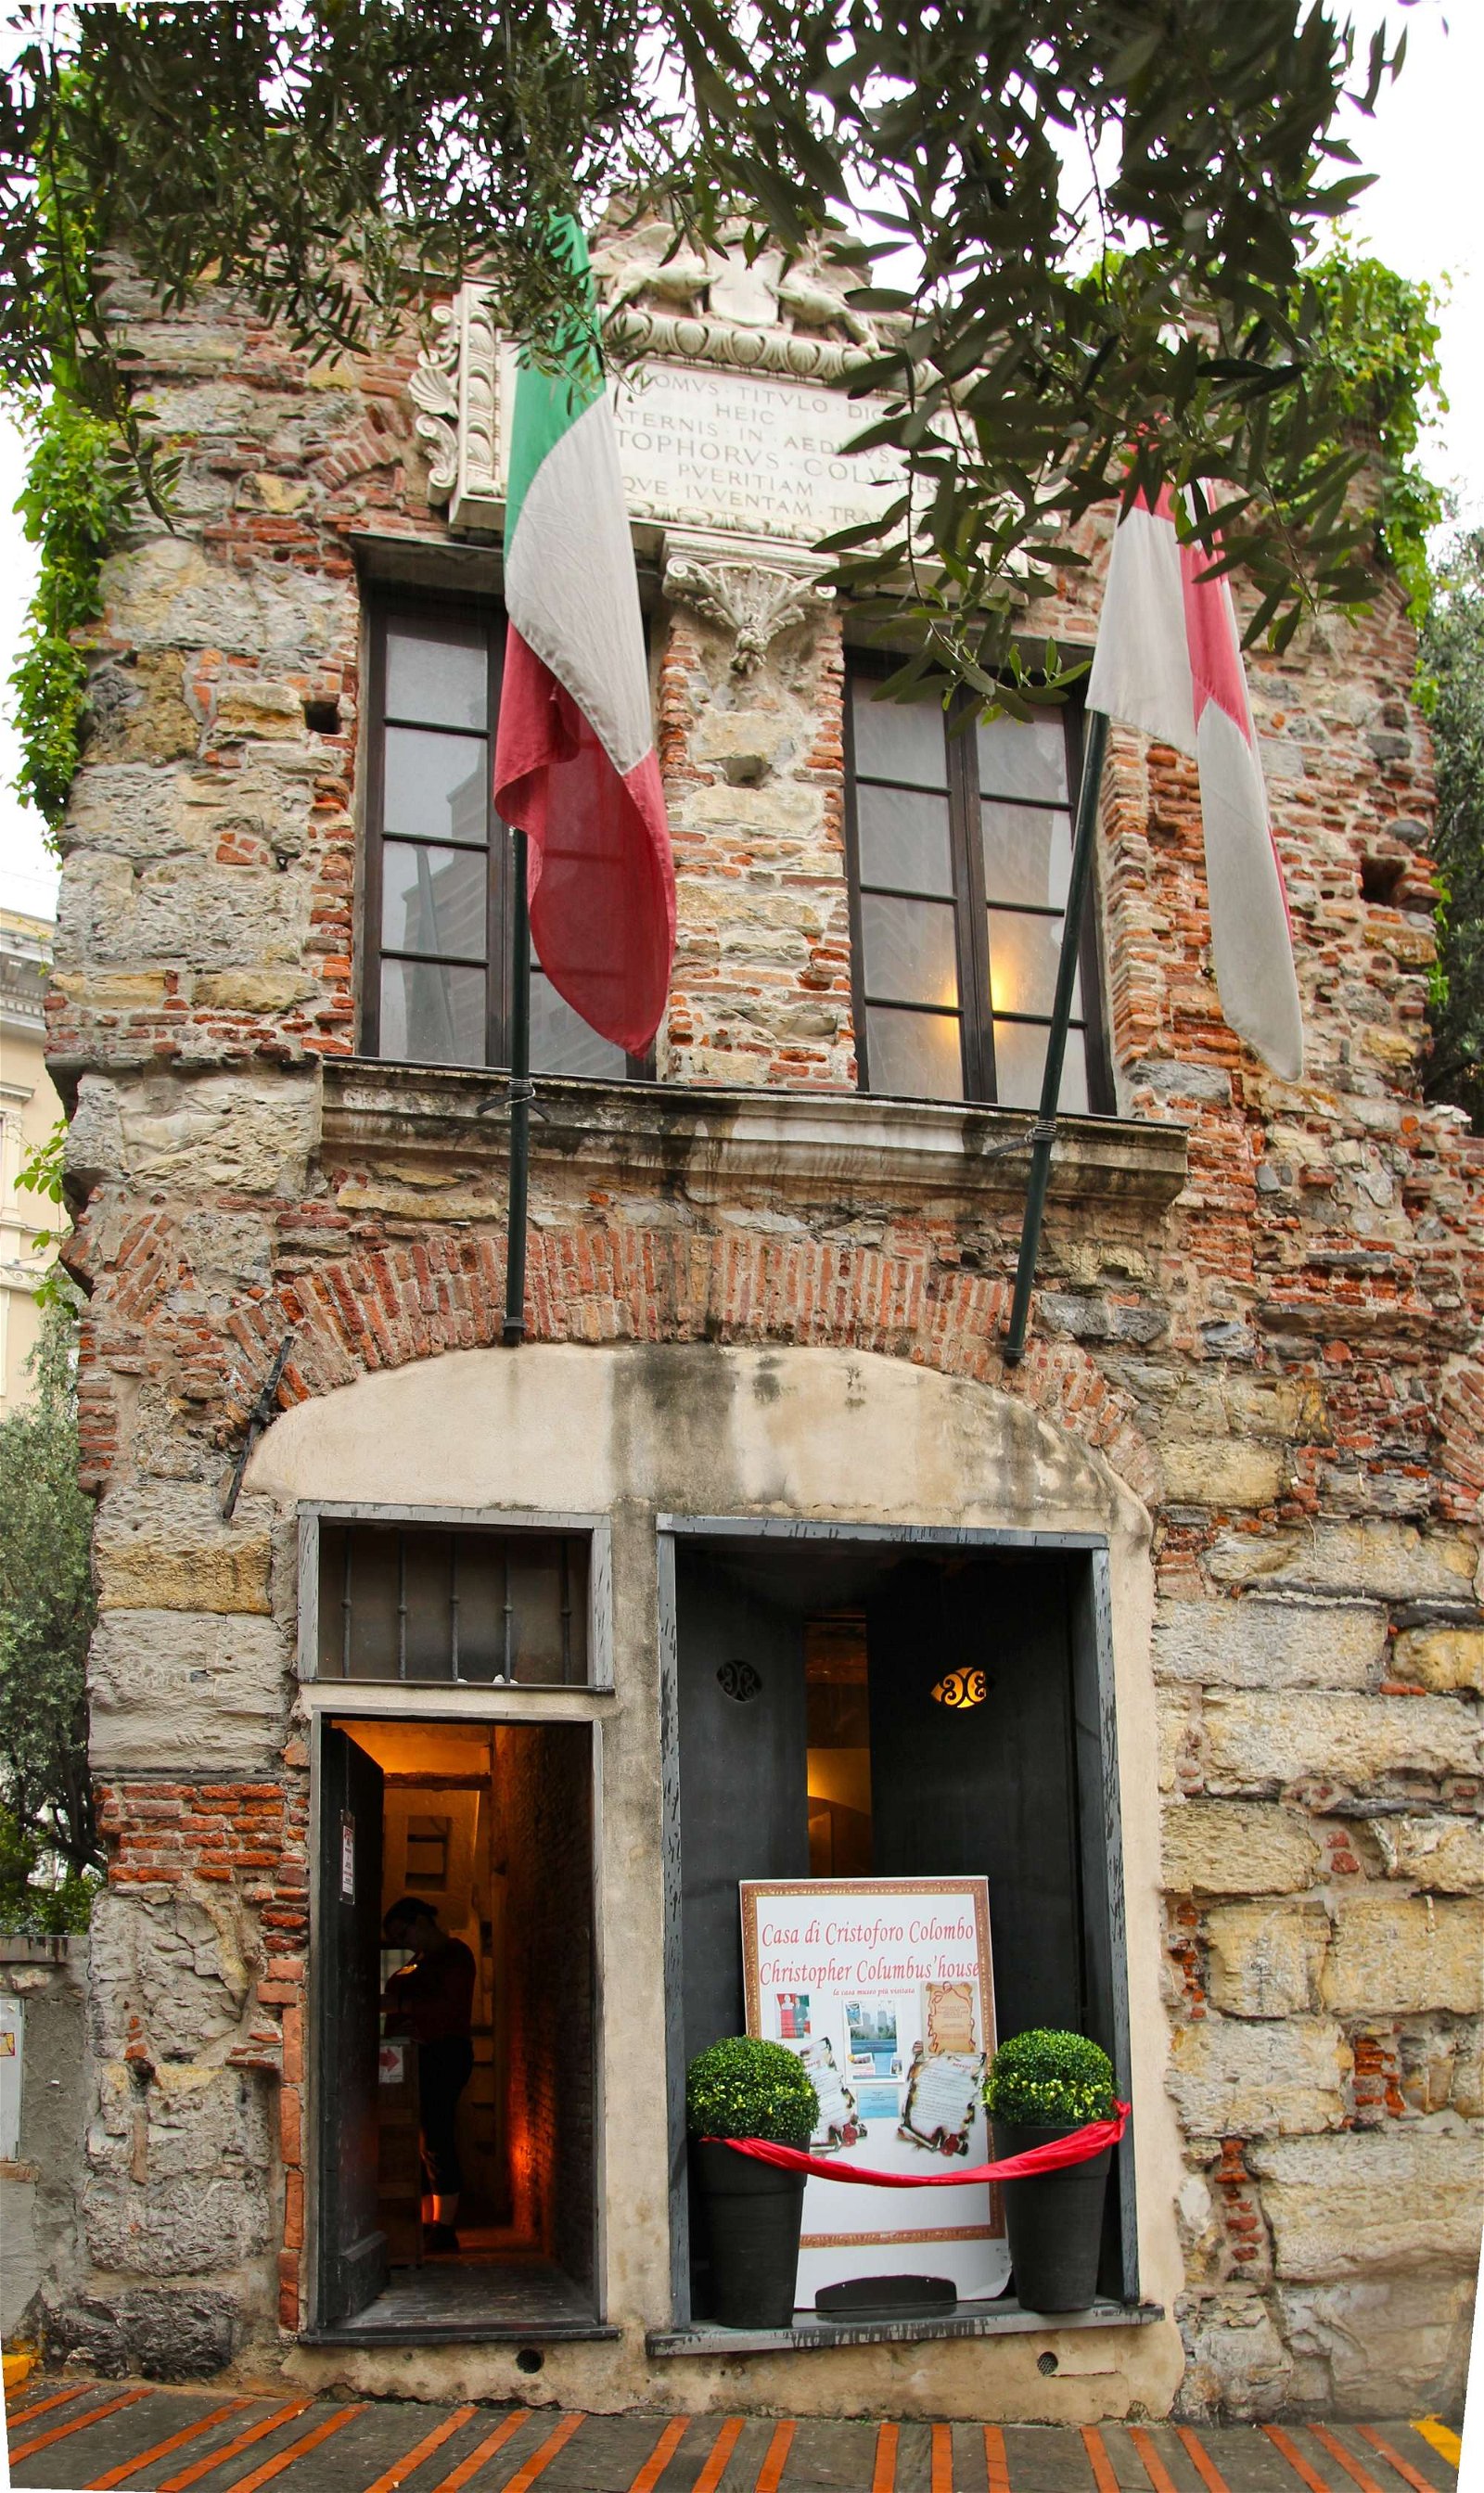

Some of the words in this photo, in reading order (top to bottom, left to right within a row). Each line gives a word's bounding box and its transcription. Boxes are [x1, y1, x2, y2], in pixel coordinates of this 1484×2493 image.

[715, 403, 775, 426] HEIC
[737, 386, 828, 415] TITVLO
[613, 406, 719, 438] ATERNIS
[739, 428, 763, 442] IN
[784, 436, 890, 464] AEDIVS
[614, 428, 779, 469] TOPHORVS
[678, 463, 813, 496] PVERITIAM
[623, 476, 669, 495] QVE
[686, 485, 812, 517] IVVENTAM
[762, 1924, 800, 1947] Casa
[804, 1920, 821, 1944] di
[825, 1918, 903, 1950] Cristoforo
[909, 1916, 974, 1943] Colombo
[761, 1957, 852, 1988] Christopher
